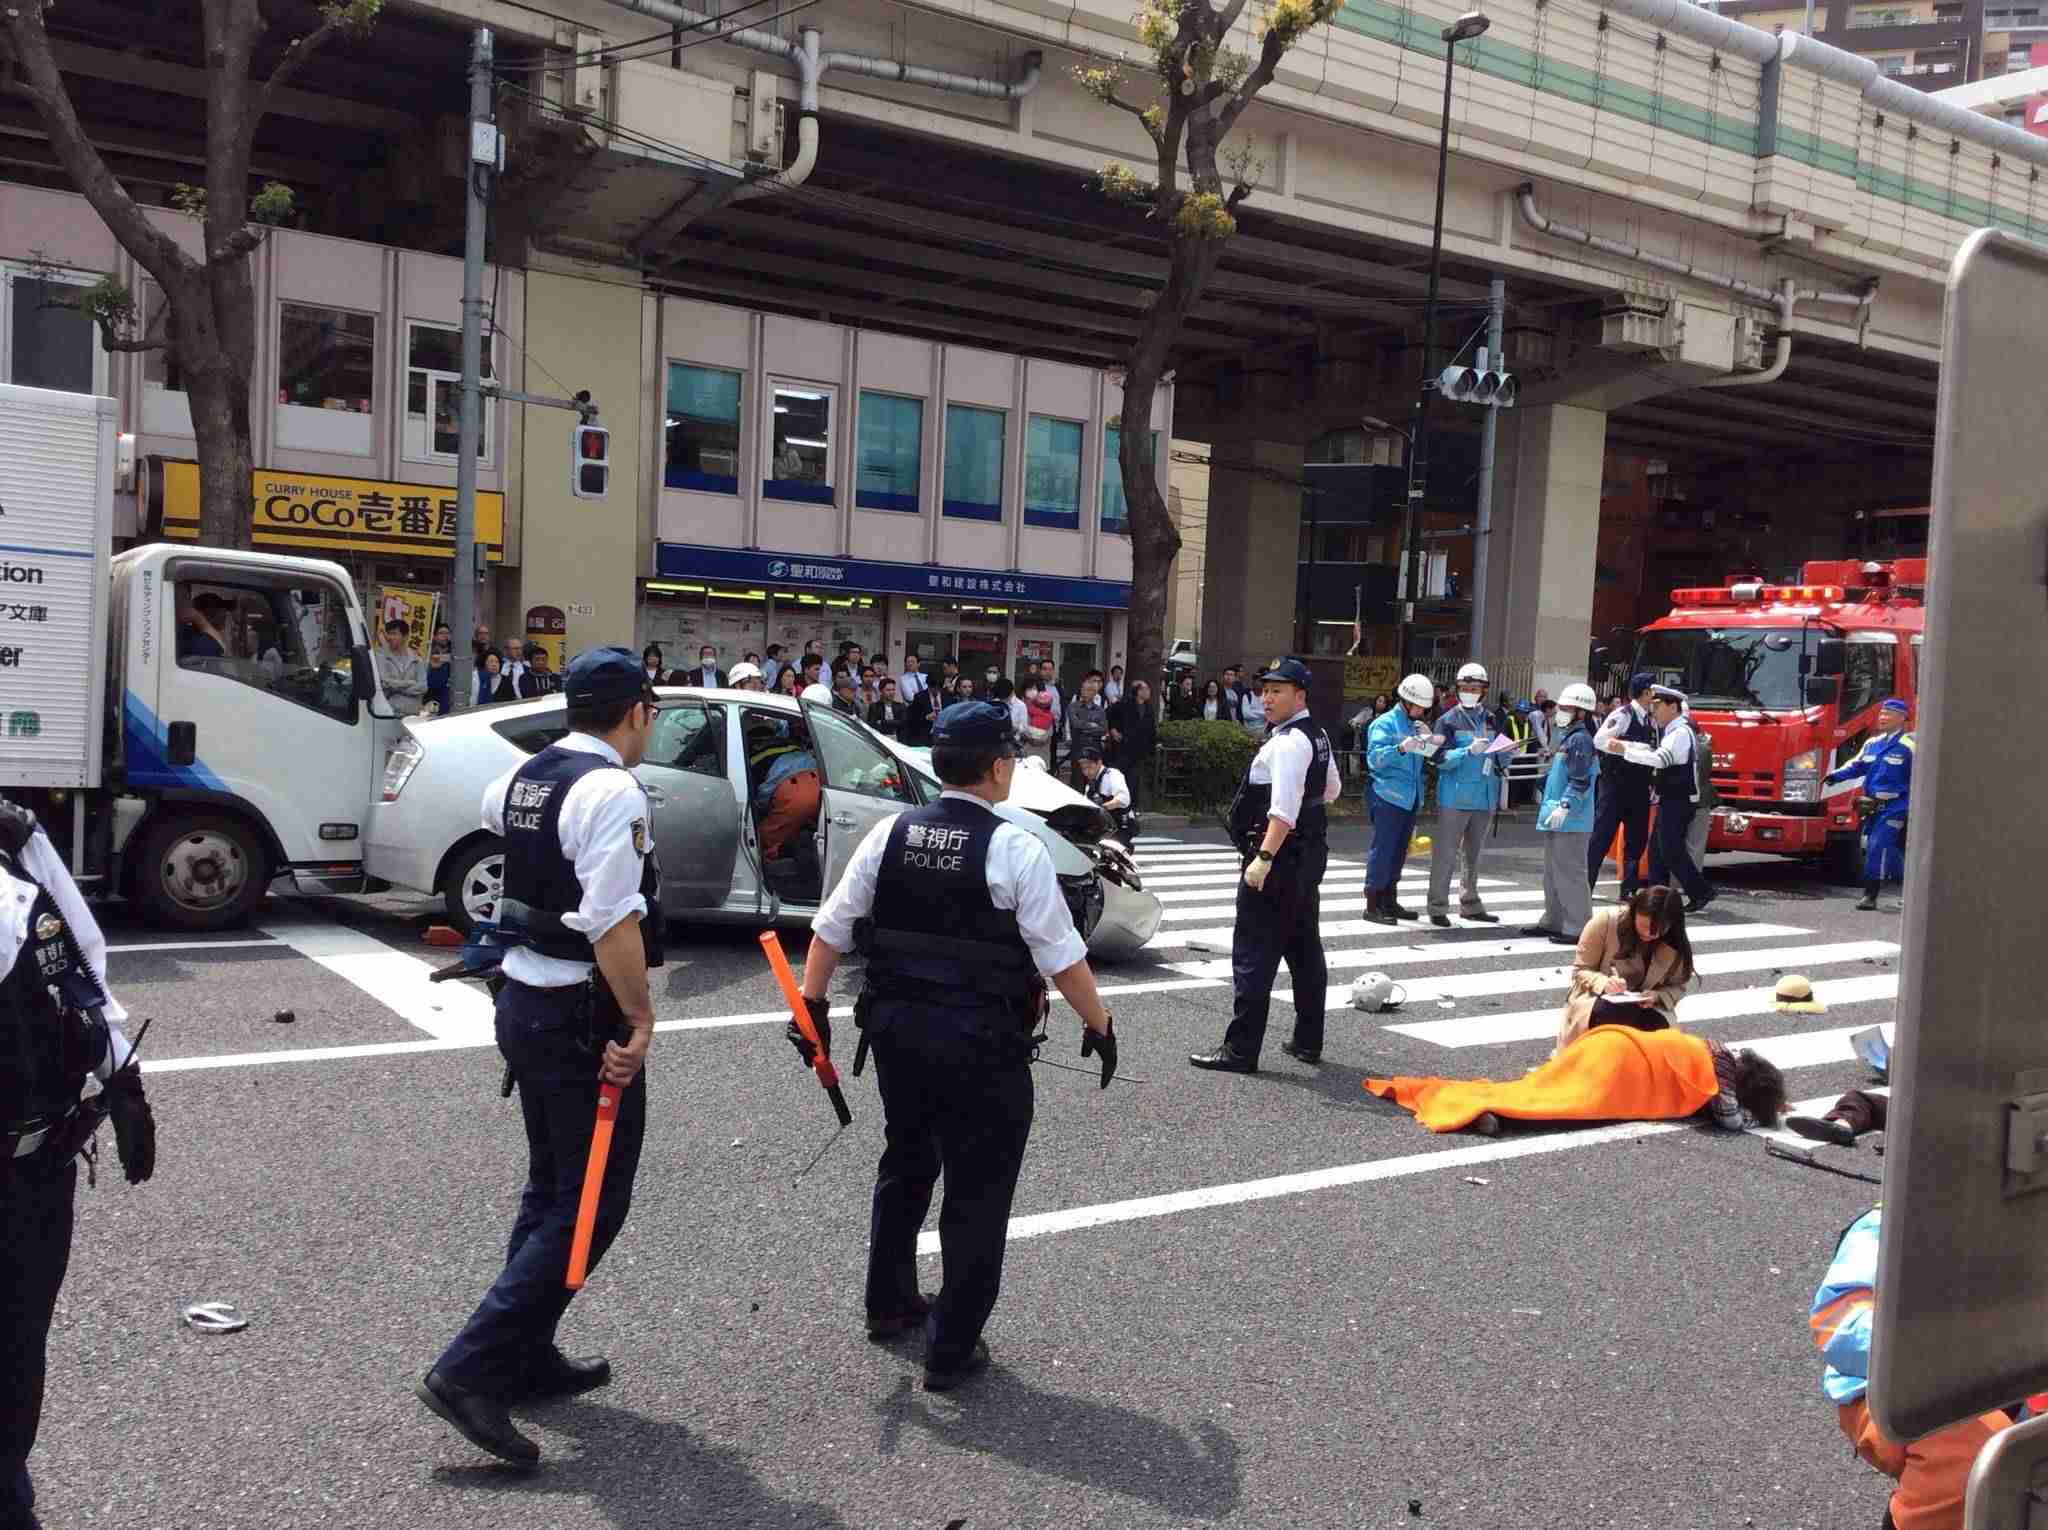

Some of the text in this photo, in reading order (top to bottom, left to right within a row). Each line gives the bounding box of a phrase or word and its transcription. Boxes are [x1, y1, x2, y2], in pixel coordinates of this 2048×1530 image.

[264, 482, 353, 500] CURRY HOUSE
[510, 782, 553, 808] 警視庁
[507, 811, 543, 830] POLICE
[905, 824, 970, 850] 警視庁
[903, 851, 965, 871] POLICE
